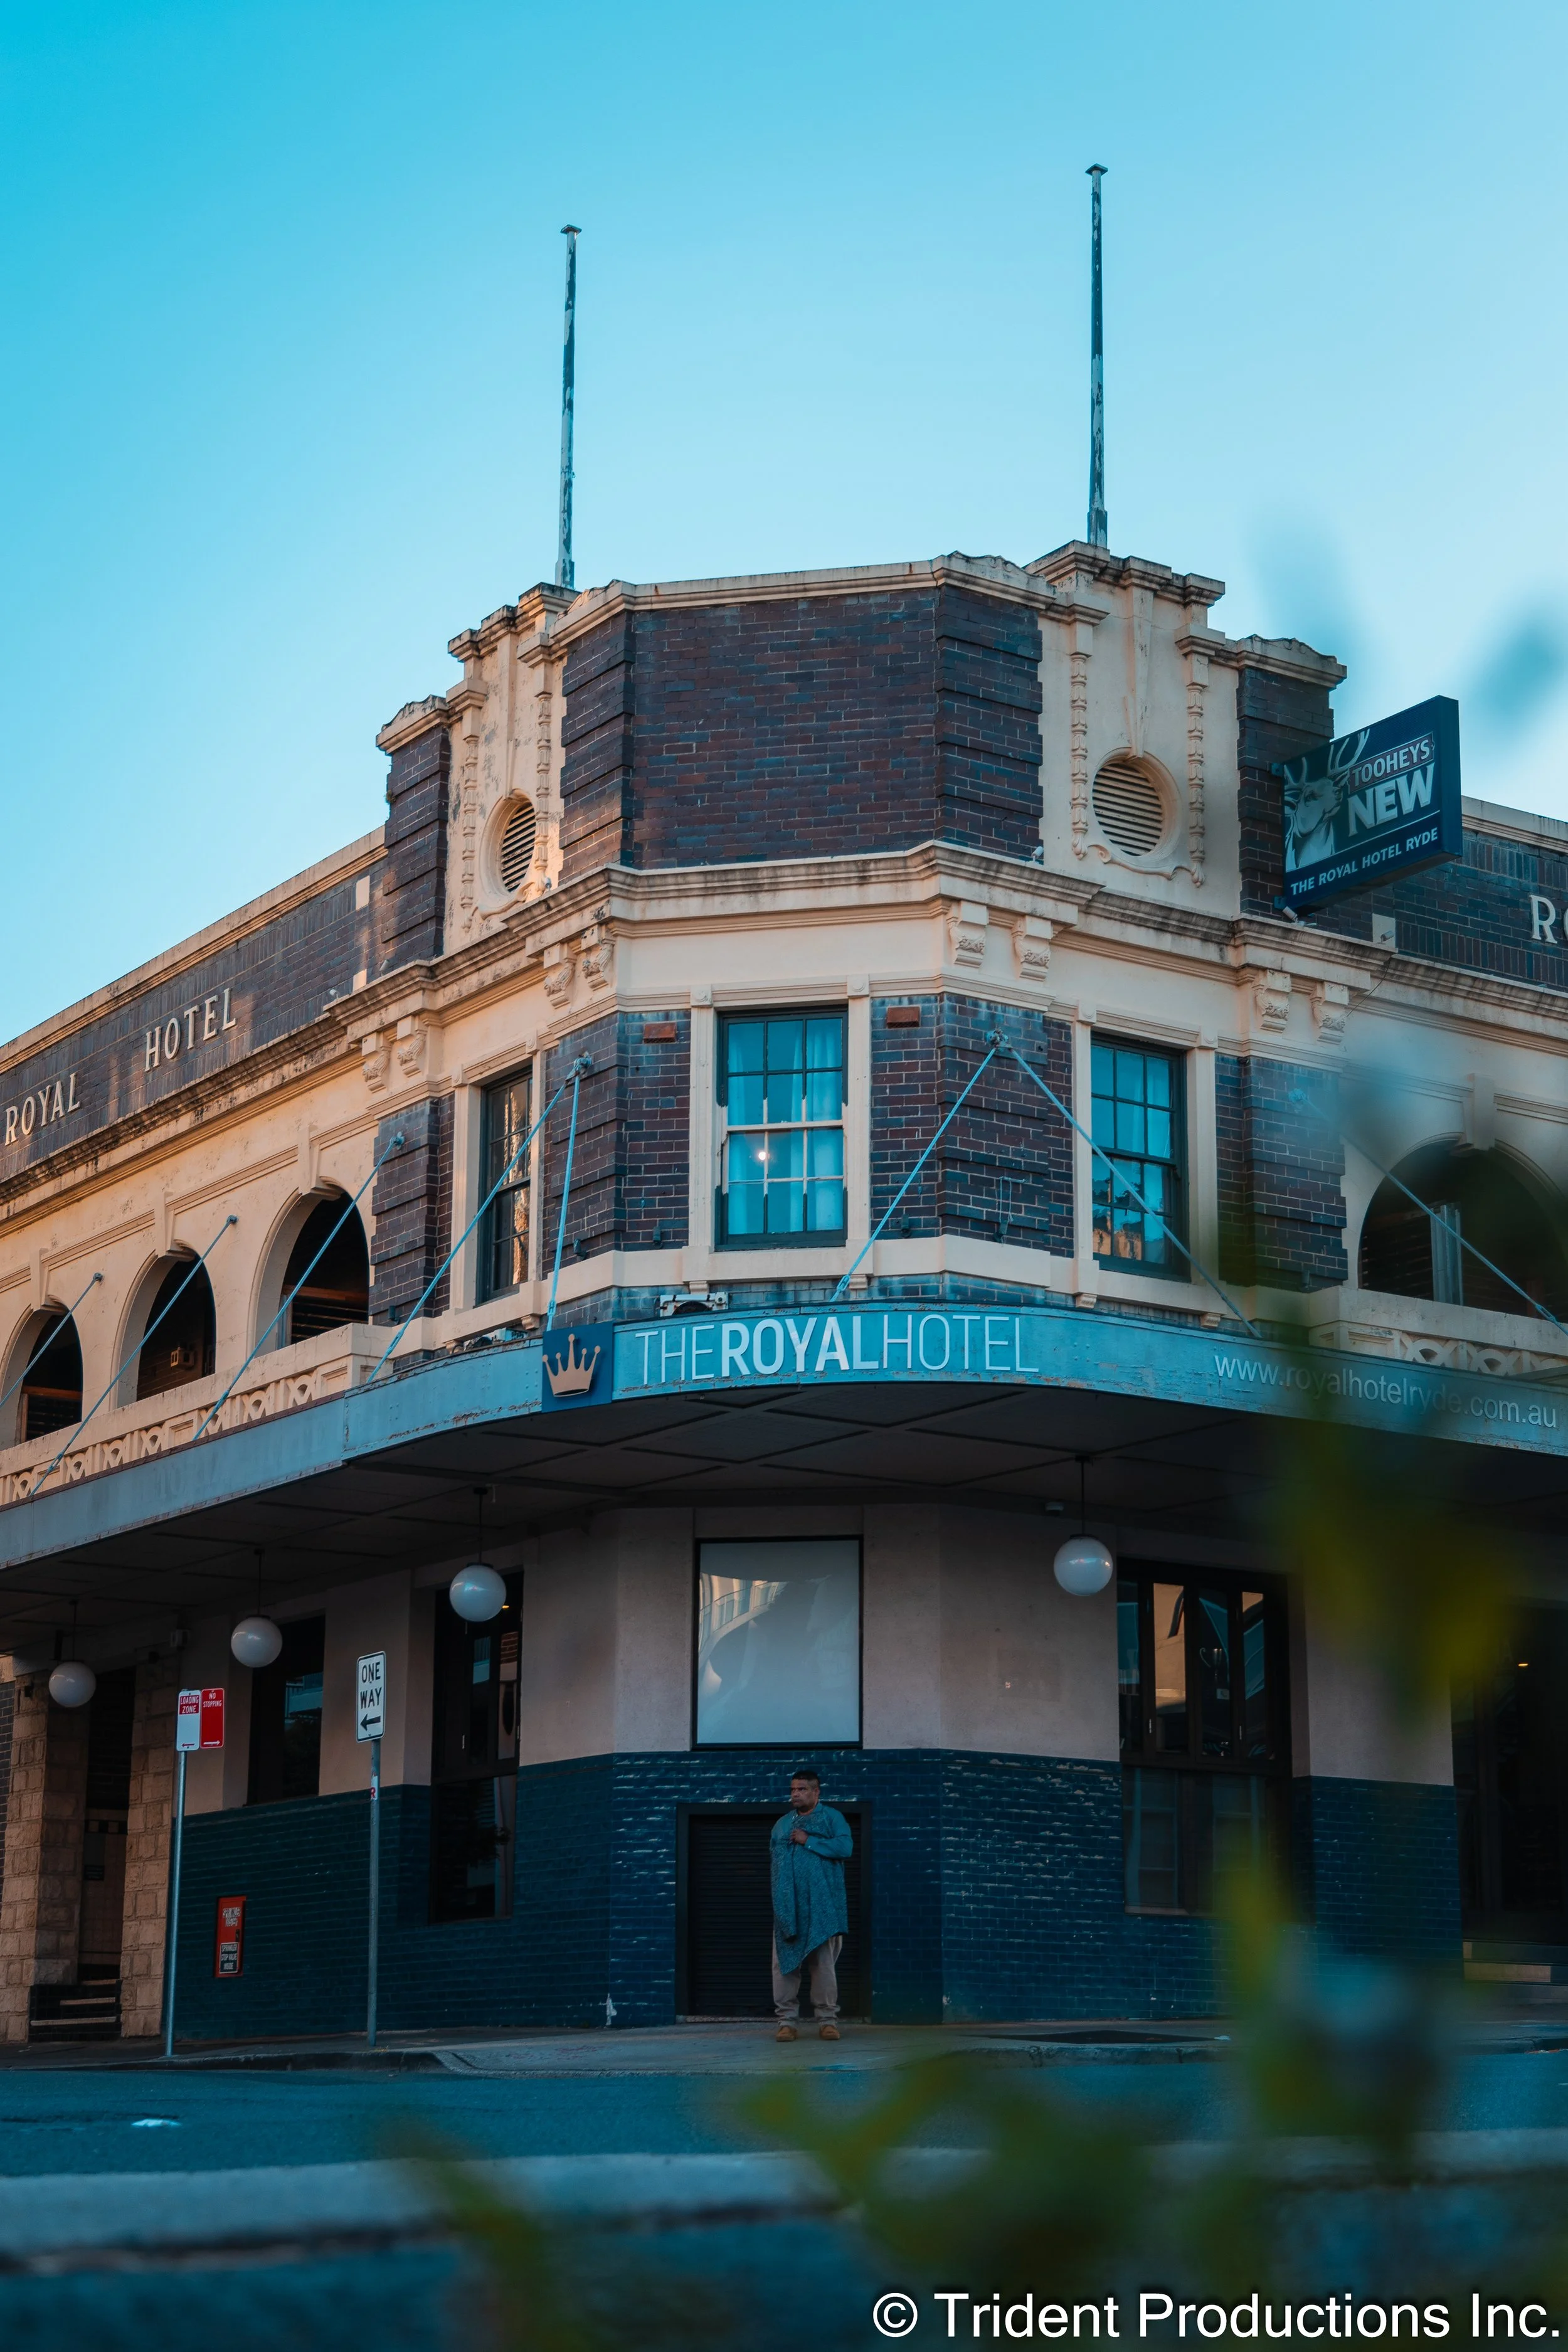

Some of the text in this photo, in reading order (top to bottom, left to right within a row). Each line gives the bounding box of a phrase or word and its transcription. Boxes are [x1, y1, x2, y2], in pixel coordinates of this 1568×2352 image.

[1352, 739, 1431, 788] TOOHEYS
[1348, 762, 1435, 837] NEW
[1290, 827, 1439, 896] THE ROYAL HOTEL RYDE
[1528, 894, 1568, 944] R
[4, 987, 238, 1147] ROYAL HOTEL
[1214, 1354, 1557, 1429] www.royalhotelryde.com.au
[361, 1661, 381, 1683] ONE
[180, 1696, 199, 1705] LOADING
[182, 1705, 197, 1714] ZONE
[203, 1700, 223, 1708] STOPPING
[360, 1687, 382, 1710] WAY
